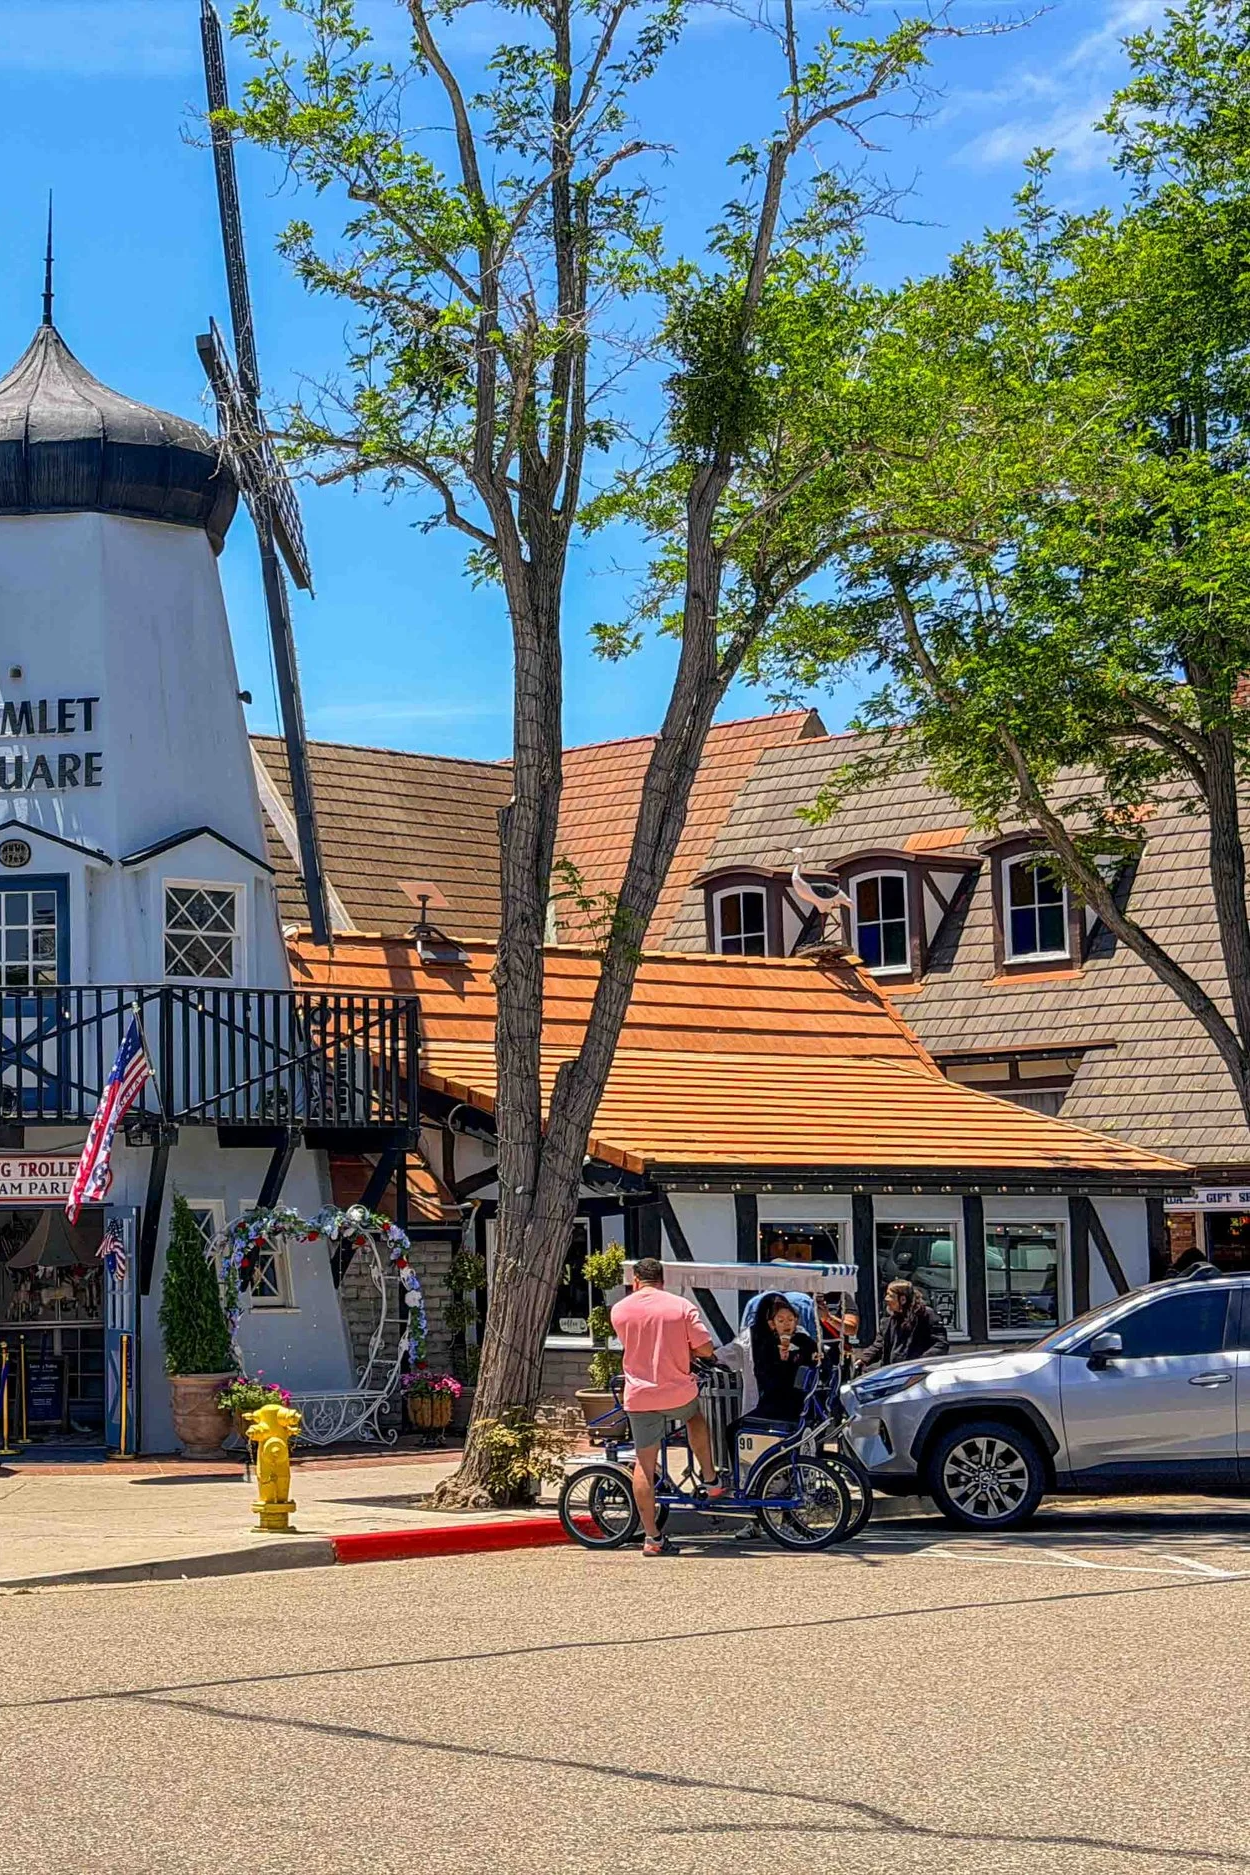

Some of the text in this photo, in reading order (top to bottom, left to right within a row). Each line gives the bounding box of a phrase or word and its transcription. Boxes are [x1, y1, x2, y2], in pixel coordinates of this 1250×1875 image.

[18, 1162, 80, 1178] TROLLE
[29, 1181, 70, 1195] PARL
[1206, 1192, 1232, 1204] GIFT
[739, 1437, 753, 1450] 90
